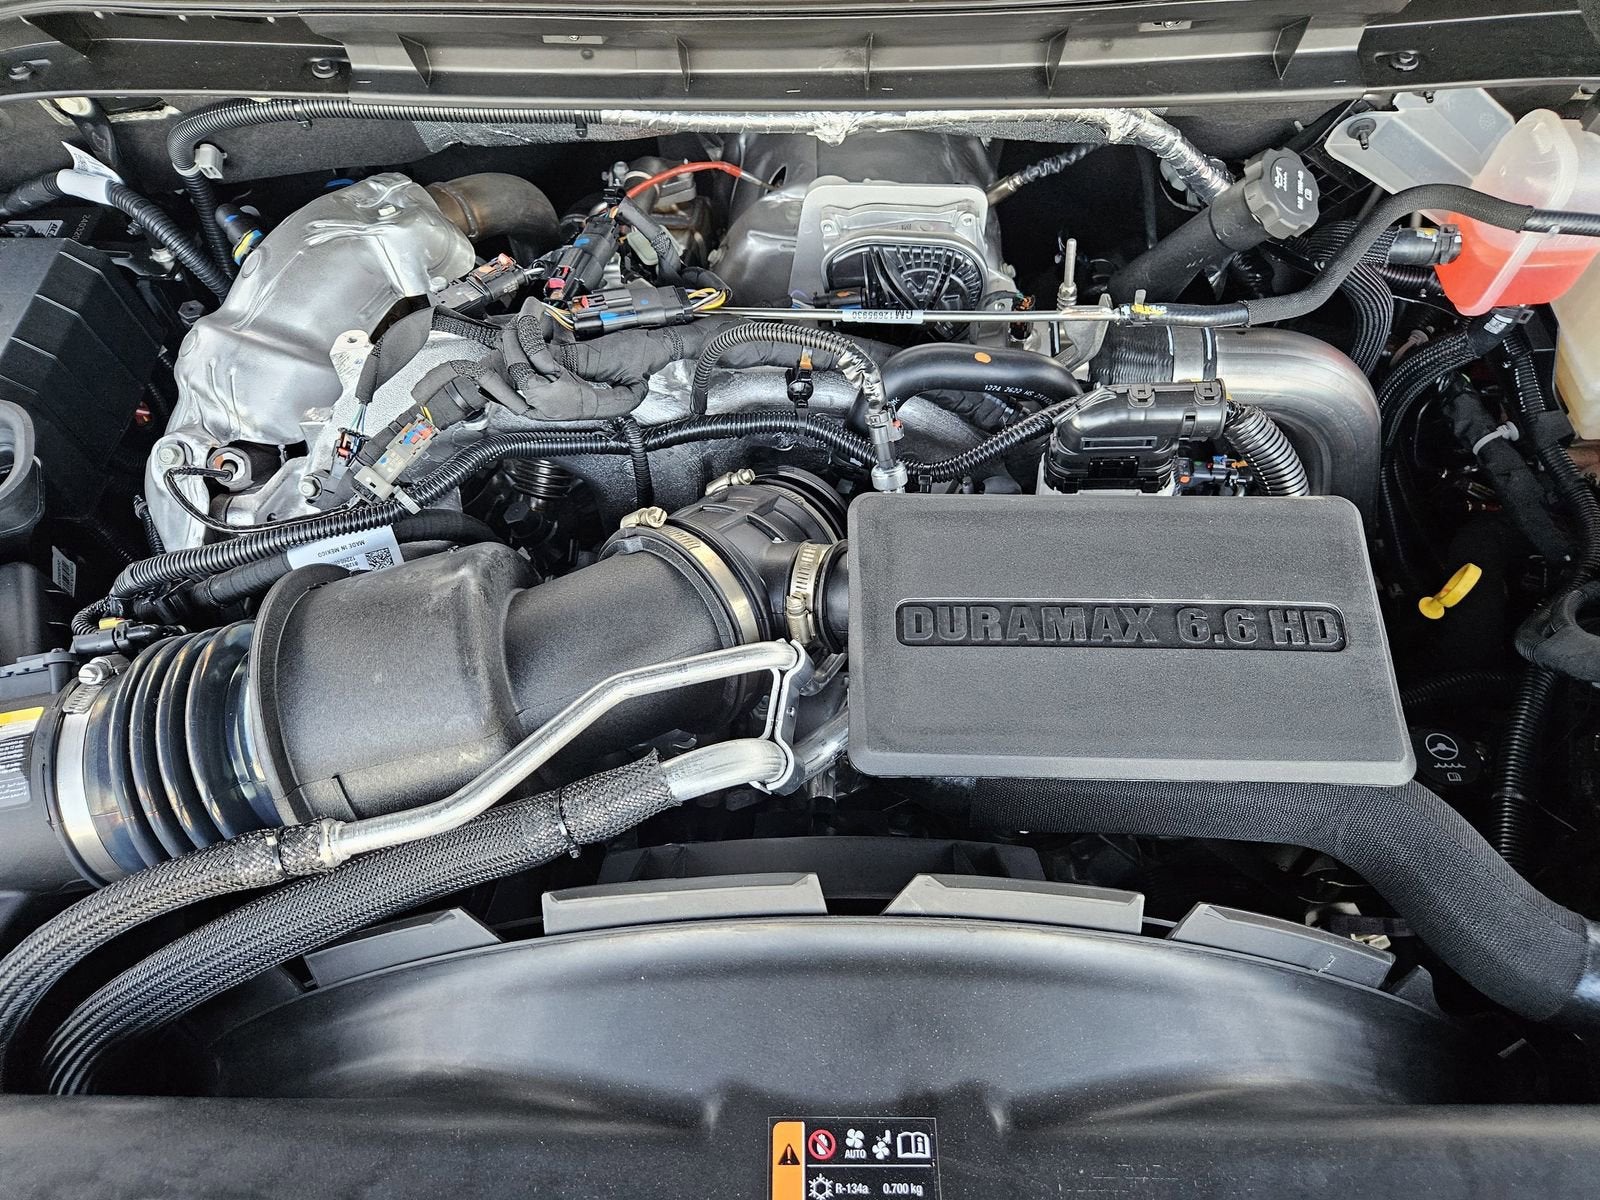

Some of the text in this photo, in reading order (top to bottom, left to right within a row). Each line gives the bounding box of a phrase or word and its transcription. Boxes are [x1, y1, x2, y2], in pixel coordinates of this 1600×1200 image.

[349, 539, 365, 549] MADE
[317, 548, 340, 558] MEXICO
[902, 605, 1342, 647] DURAMAX 6.6 HD
[844, 1149, 867, 1160] AUTO
[835, 1183, 924, 1197] R-134a 0.700 kg
